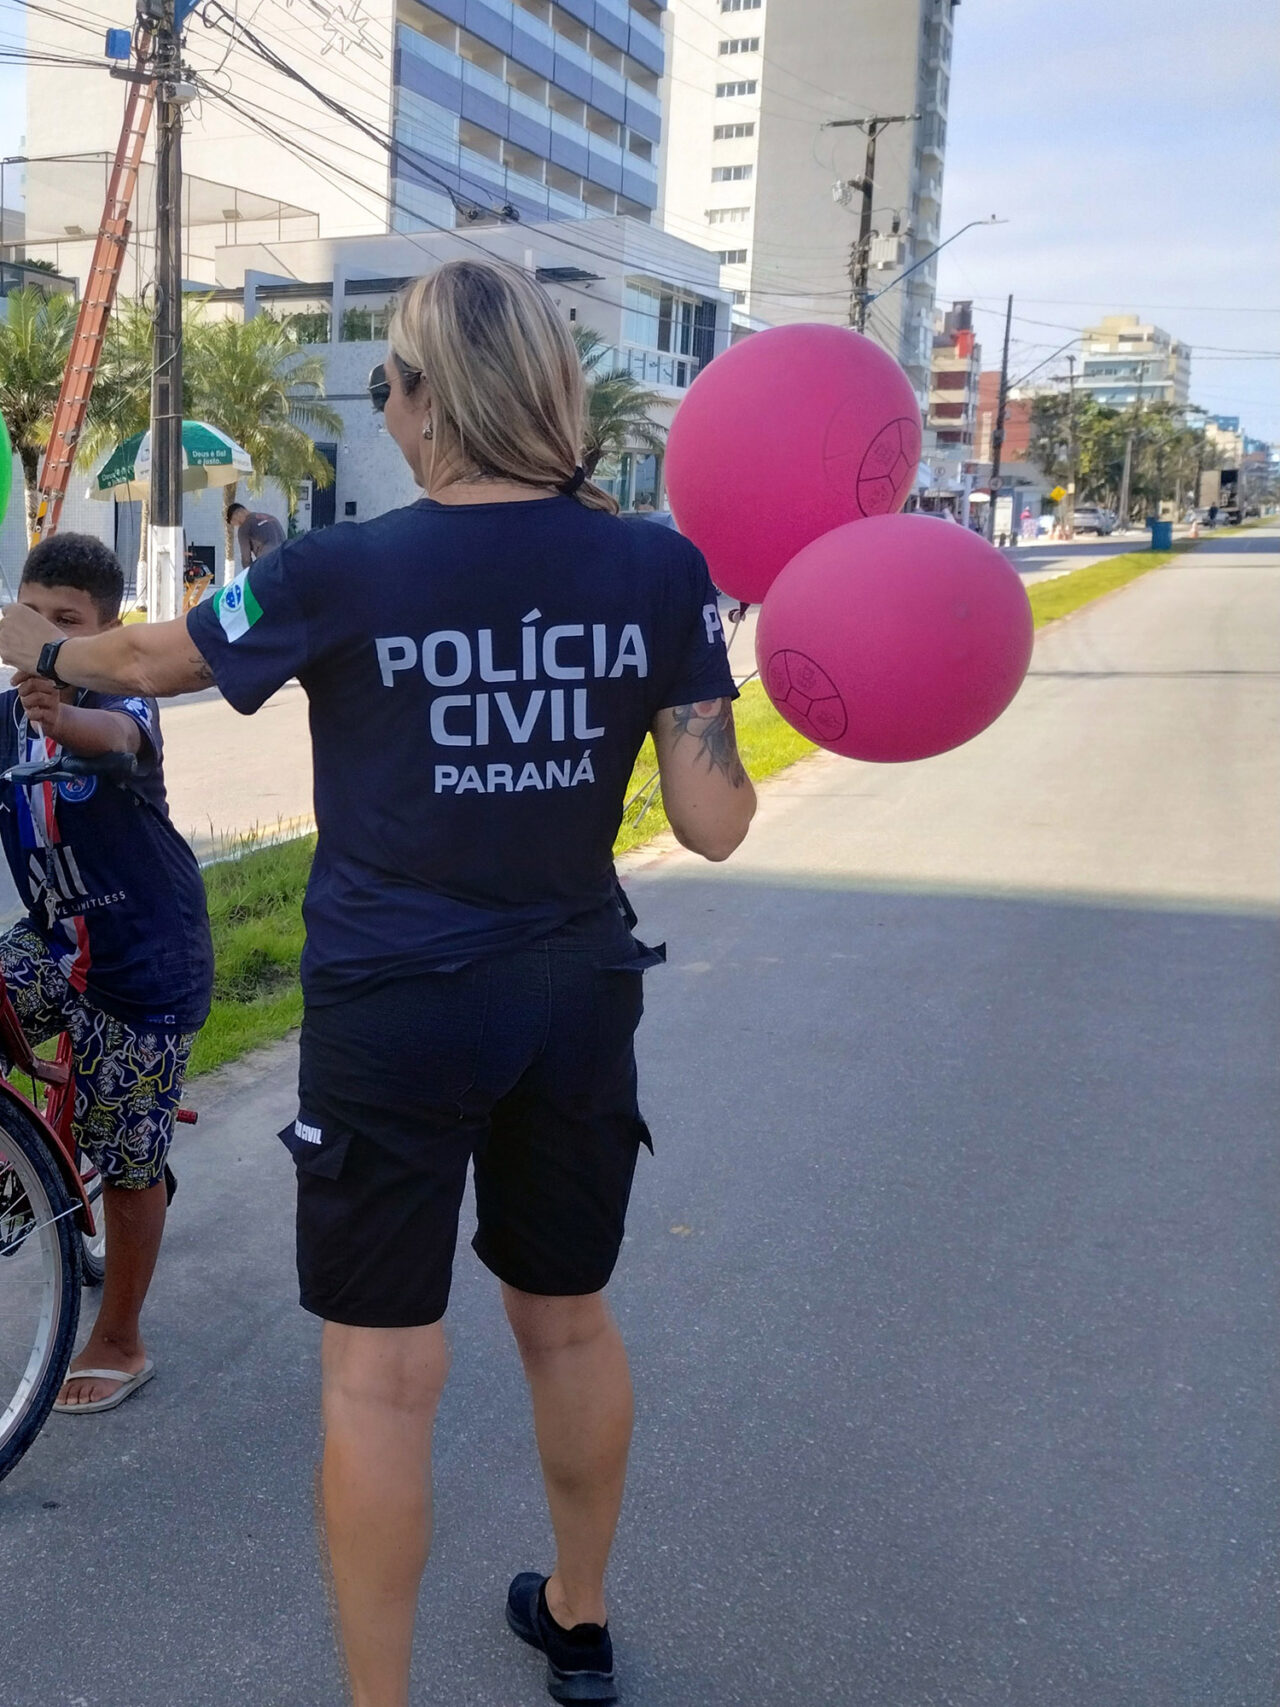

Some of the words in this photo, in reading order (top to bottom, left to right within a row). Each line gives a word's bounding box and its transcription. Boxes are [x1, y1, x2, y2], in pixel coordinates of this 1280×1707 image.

[375, 608, 648, 687] POLÍCIA
[702, 603, 725, 643] P
[430, 688, 605, 746] CIVIL
[434, 749, 595, 794] PARANÁ
